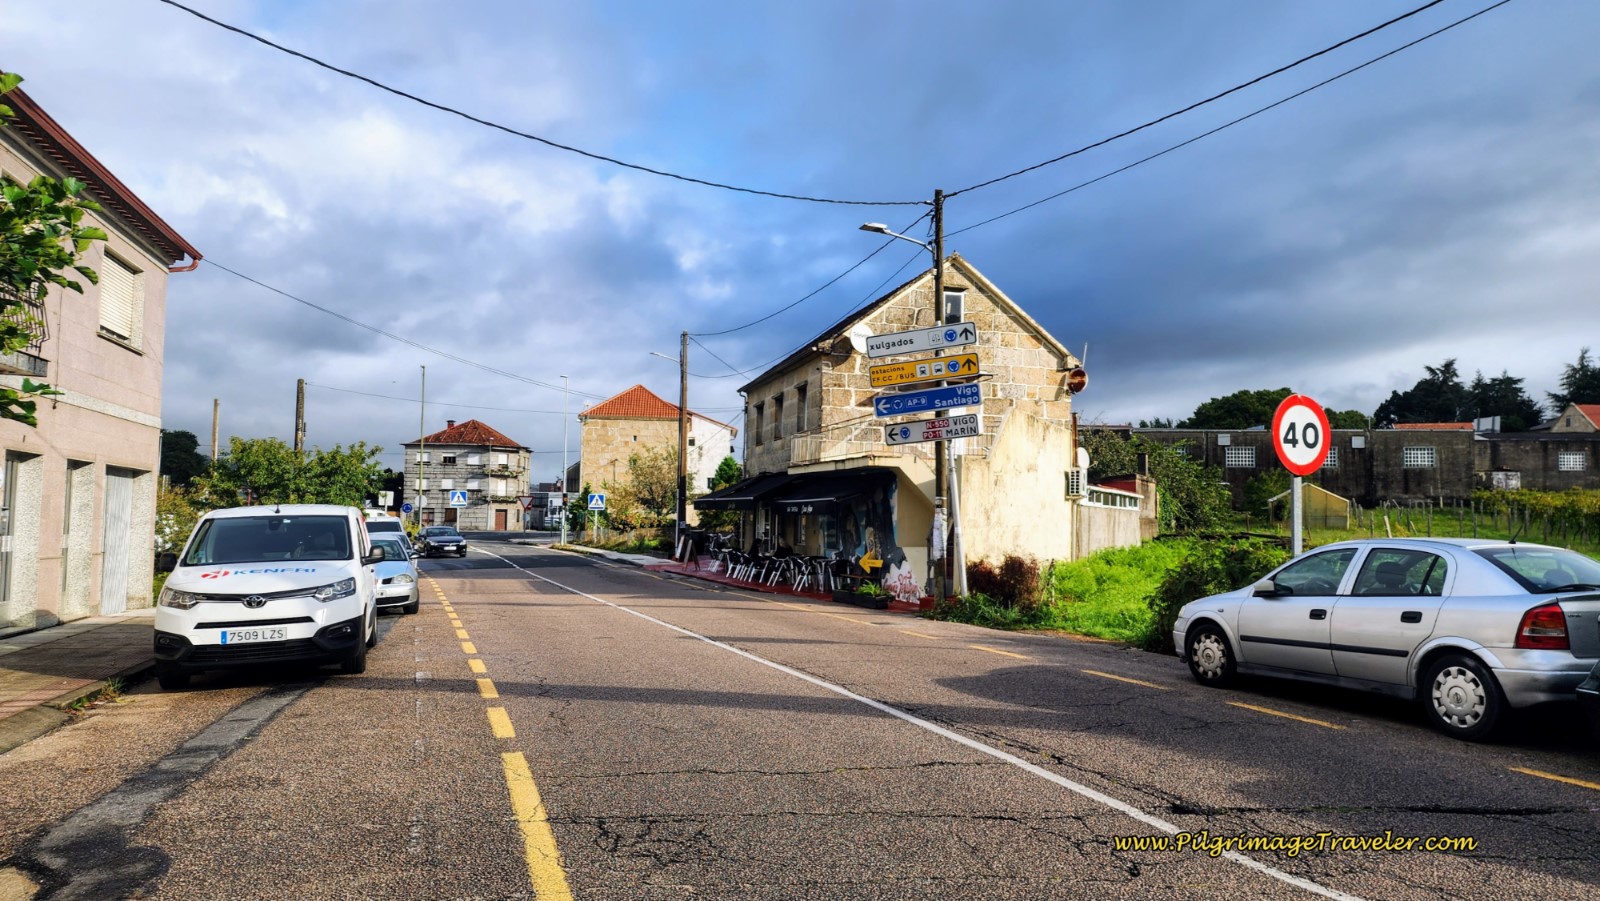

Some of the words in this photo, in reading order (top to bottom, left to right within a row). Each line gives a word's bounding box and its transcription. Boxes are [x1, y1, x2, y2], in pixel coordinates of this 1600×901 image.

[869, 338, 914, 350] xulgados
[871, 366, 905, 375] estacions
[956, 386, 978, 396] Vigo
[907, 398, 926, 406] AP-9
[934, 395, 979, 408] Santiago
[926, 420, 949, 428] N-550
[952, 416, 976, 426] VIGO
[923, 430, 942, 439] PO-11
[946, 425, 977, 437] MARÍN
[1283, 421, 1320, 449] 40
[229, 630, 258, 642] 7509
[262, 629, 284, 640] LZS
